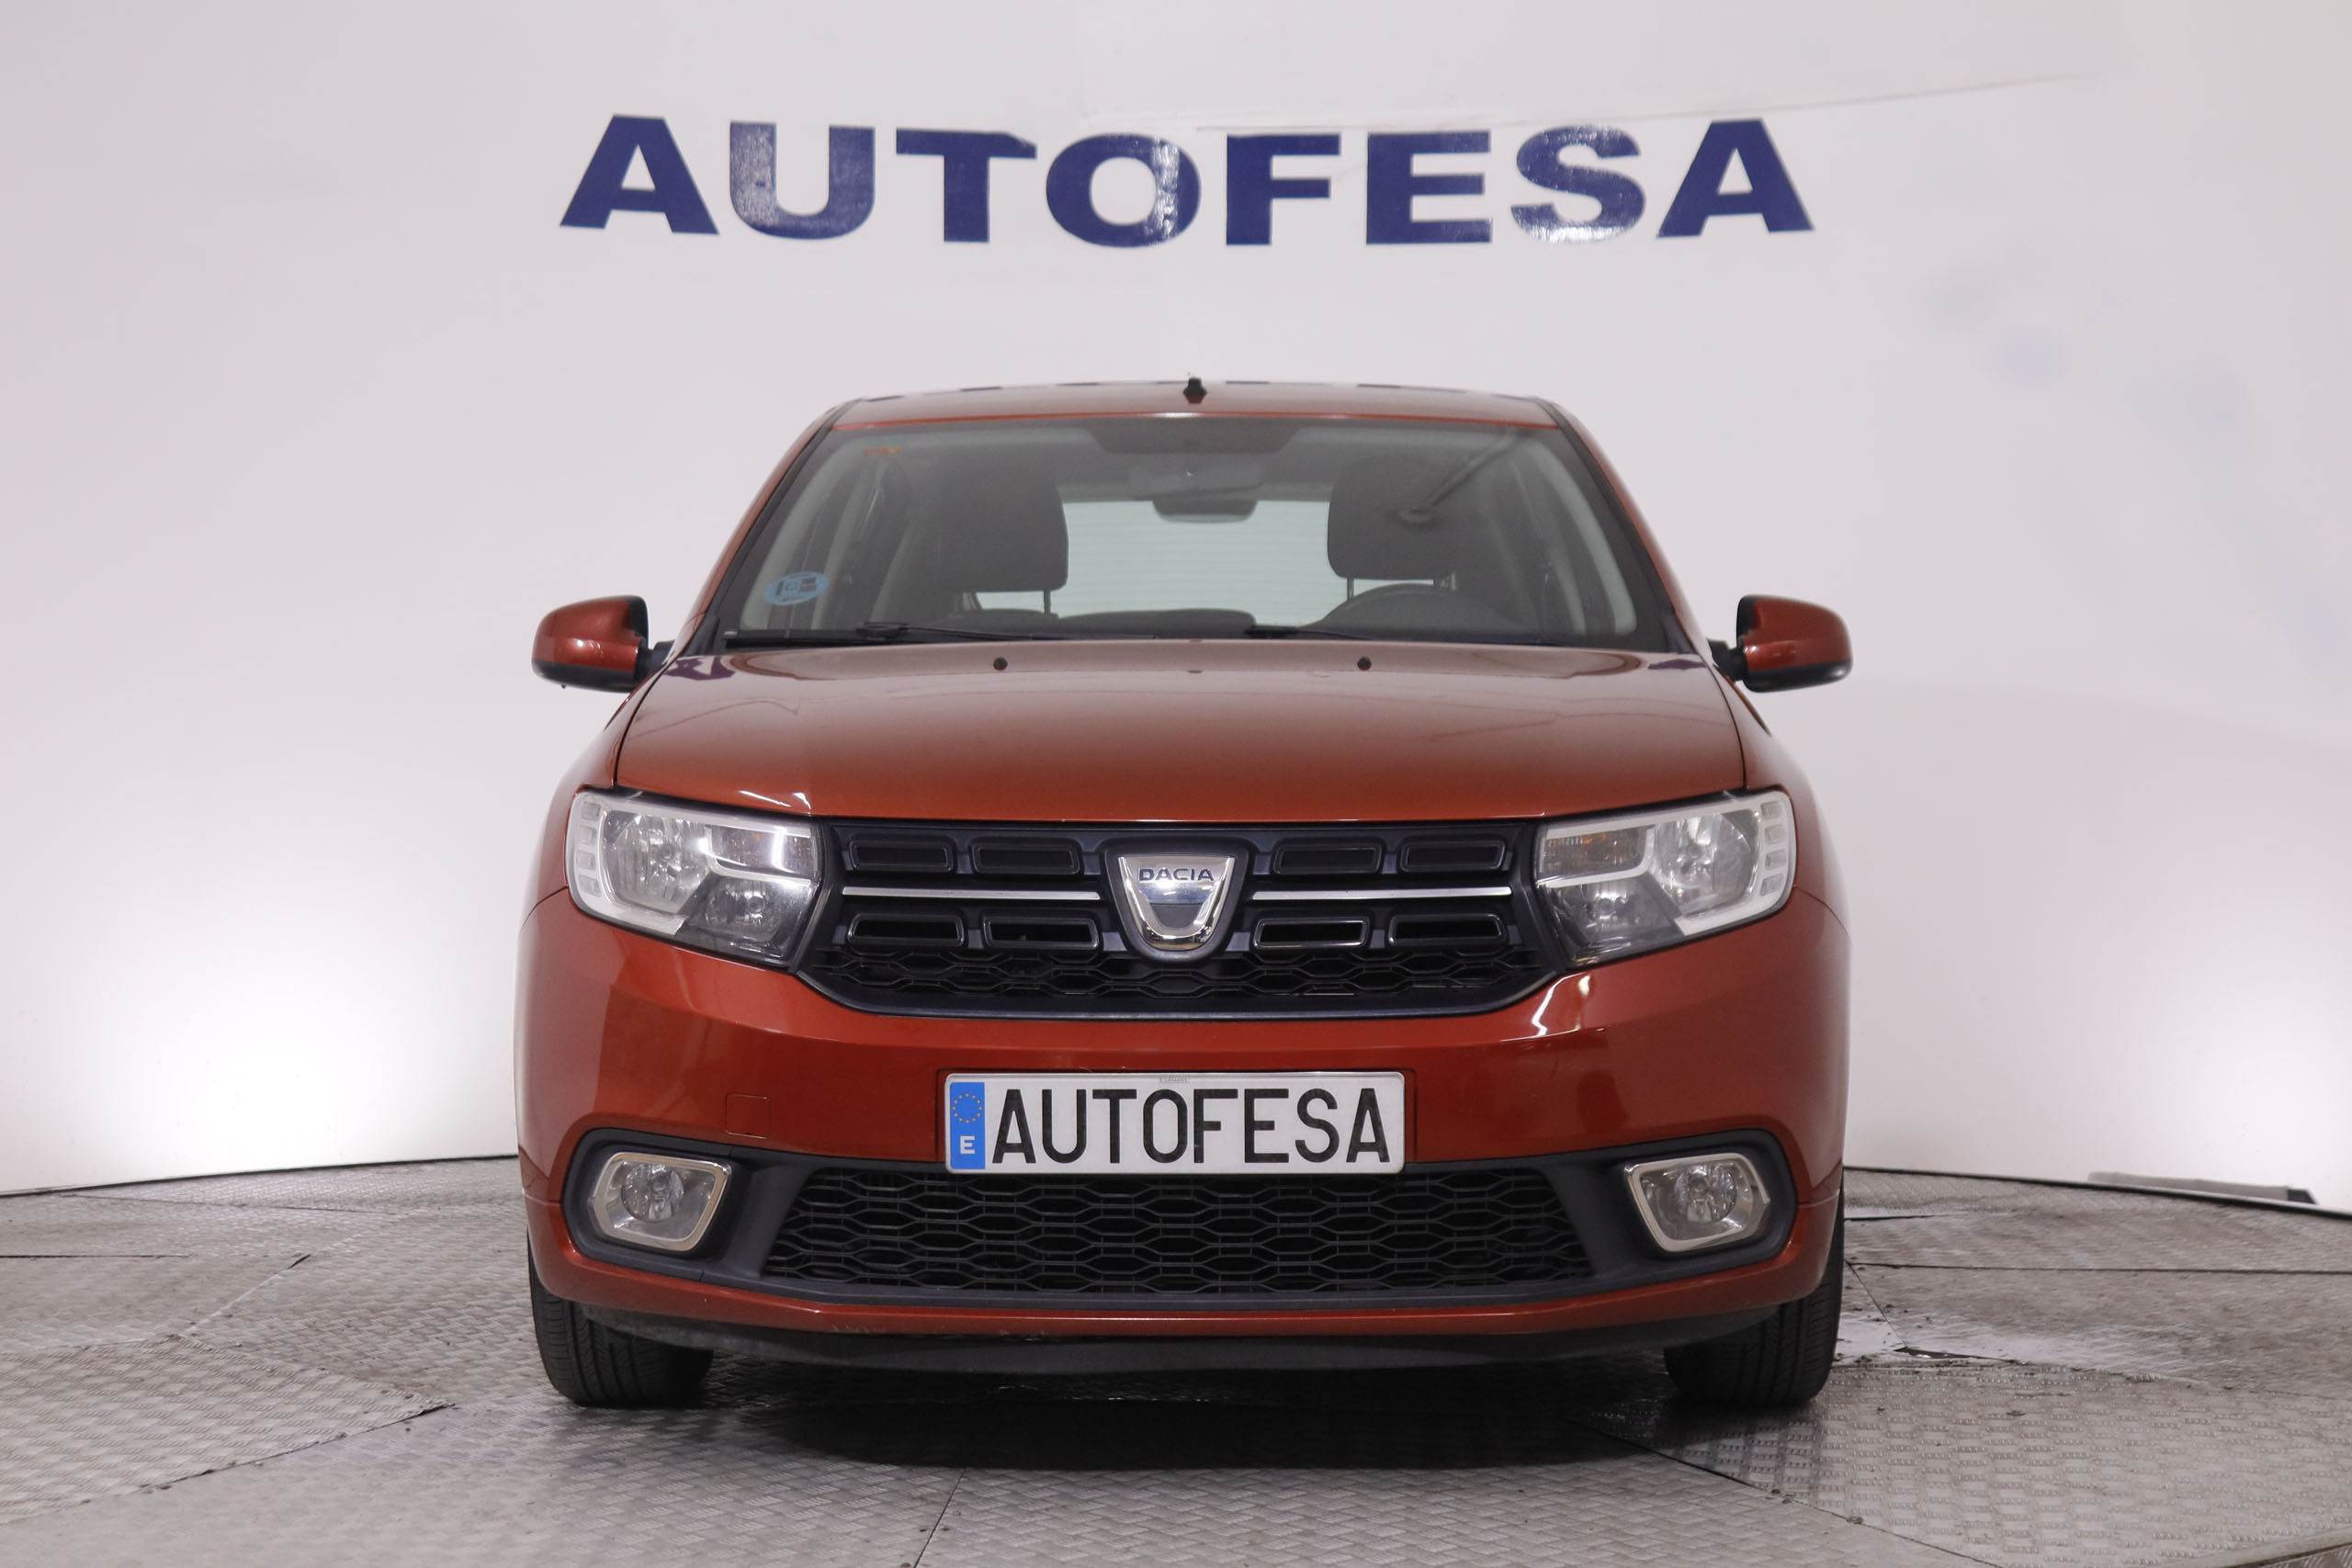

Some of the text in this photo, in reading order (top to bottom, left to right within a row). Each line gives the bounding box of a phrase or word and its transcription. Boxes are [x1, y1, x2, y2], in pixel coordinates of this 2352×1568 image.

[559, 114, 1815, 246] AUTOFESA
[1139, 866, 1215, 882] DACIA
[960, 1135, 976, 1155] E
[992, 1088, 1390, 1164] AUTOFESA
